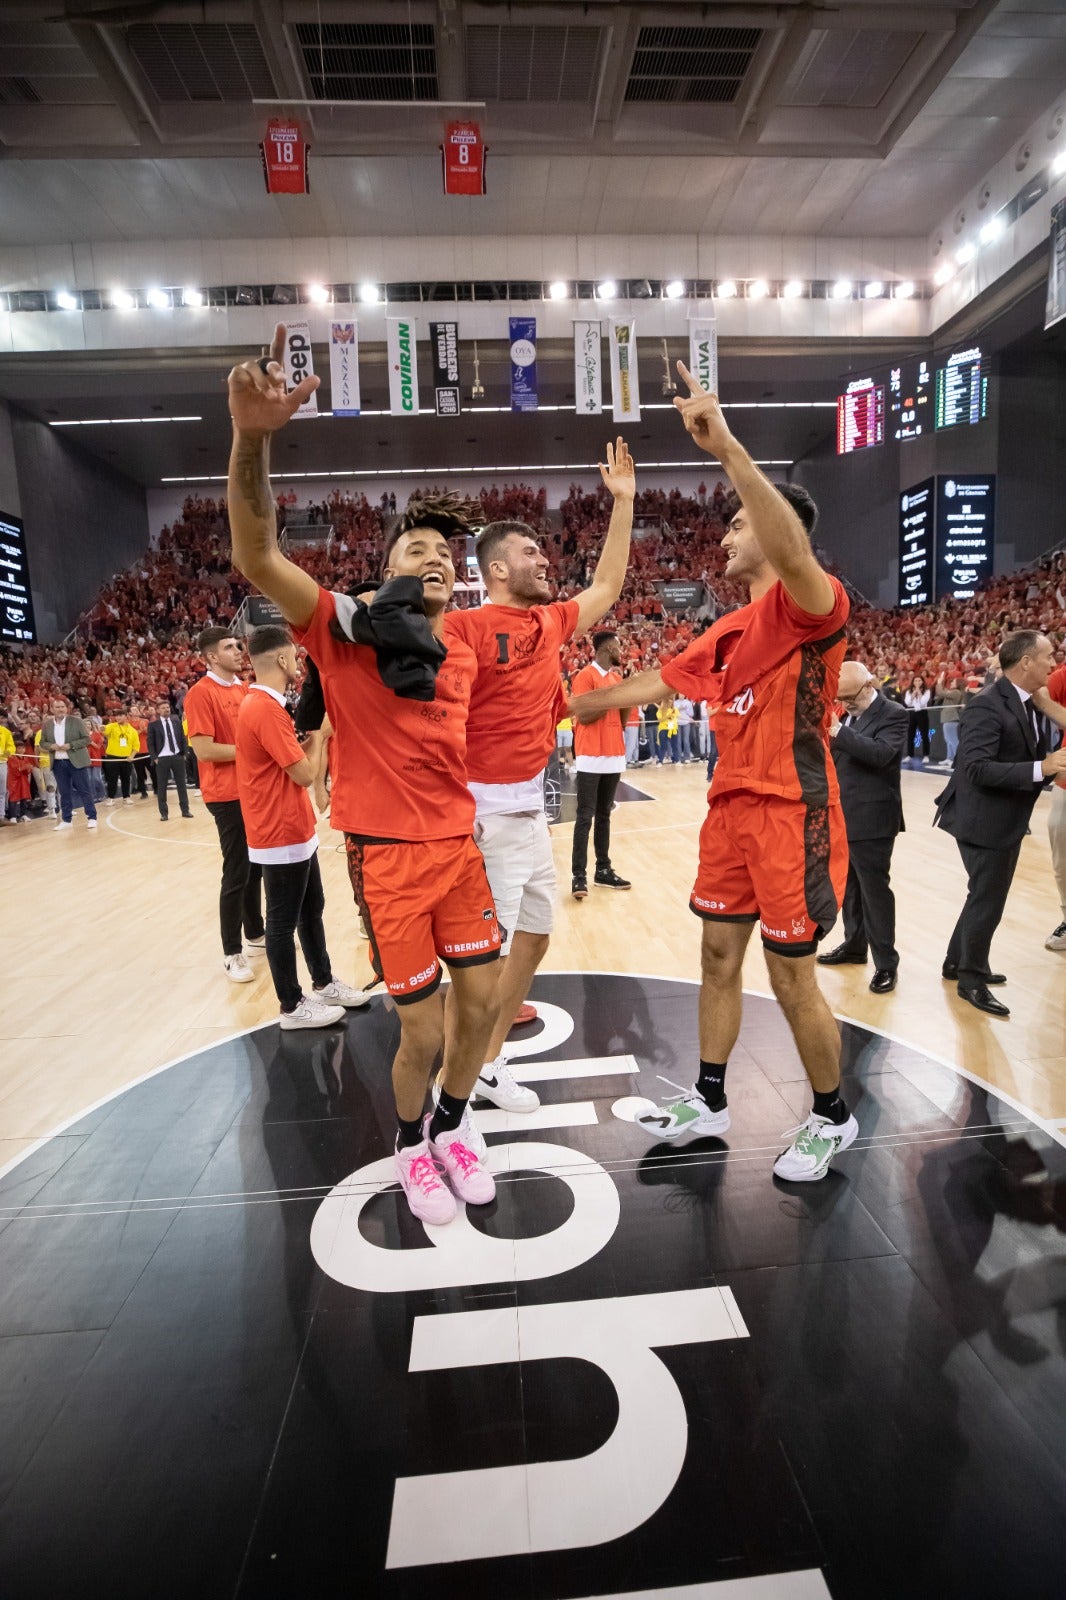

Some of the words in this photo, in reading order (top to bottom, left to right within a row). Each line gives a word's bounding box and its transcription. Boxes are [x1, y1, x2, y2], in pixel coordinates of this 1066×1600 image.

[276, 142, 294, 163] 18
[459, 144, 469, 165] 8
[437, 324, 445, 333] DE
[438, 335, 448, 369] VERDAD
[445, 323, 459, 381] BURGERS
[398, 322, 413, 412] COVIRAN
[621, 370, 631, 413] ALHAMBRA
[454, 939, 490, 953] BERNER
[408, 965, 436, 987] asisa
